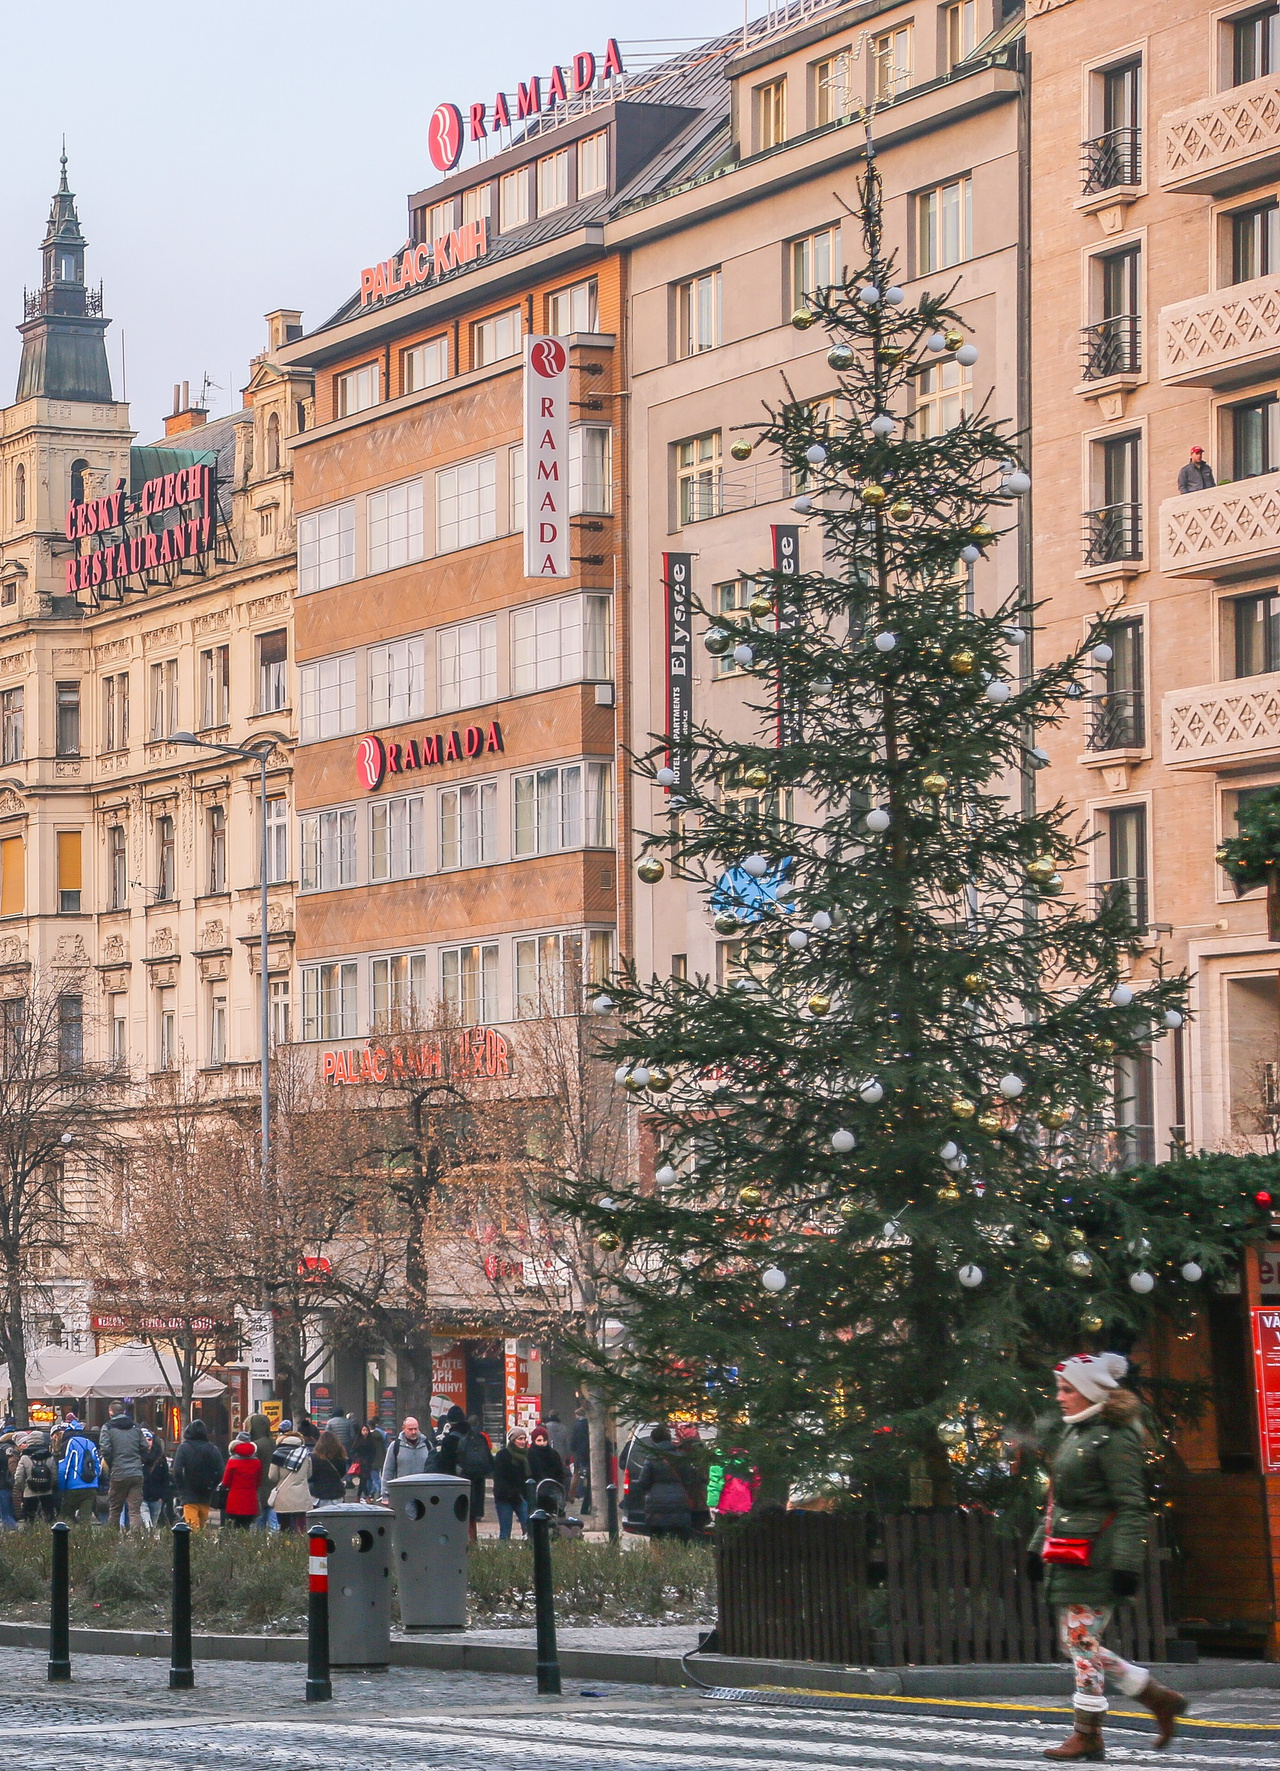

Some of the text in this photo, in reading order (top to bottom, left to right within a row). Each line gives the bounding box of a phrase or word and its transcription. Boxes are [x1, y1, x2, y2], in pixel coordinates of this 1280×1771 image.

[470, 38, 622, 140] RAMADA
[360, 217, 489, 306] PALÁC KNIH
[65, 478, 125, 541] ČESKÝ
[142, 464, 206, 515] CZECH
[537, 397, 559, 574] RAMADA
[671, 563, 690, 676] Elysee
[387, 721, 503, 772] RAMADA
[323, 1039, 387, 1085] PALÁC
